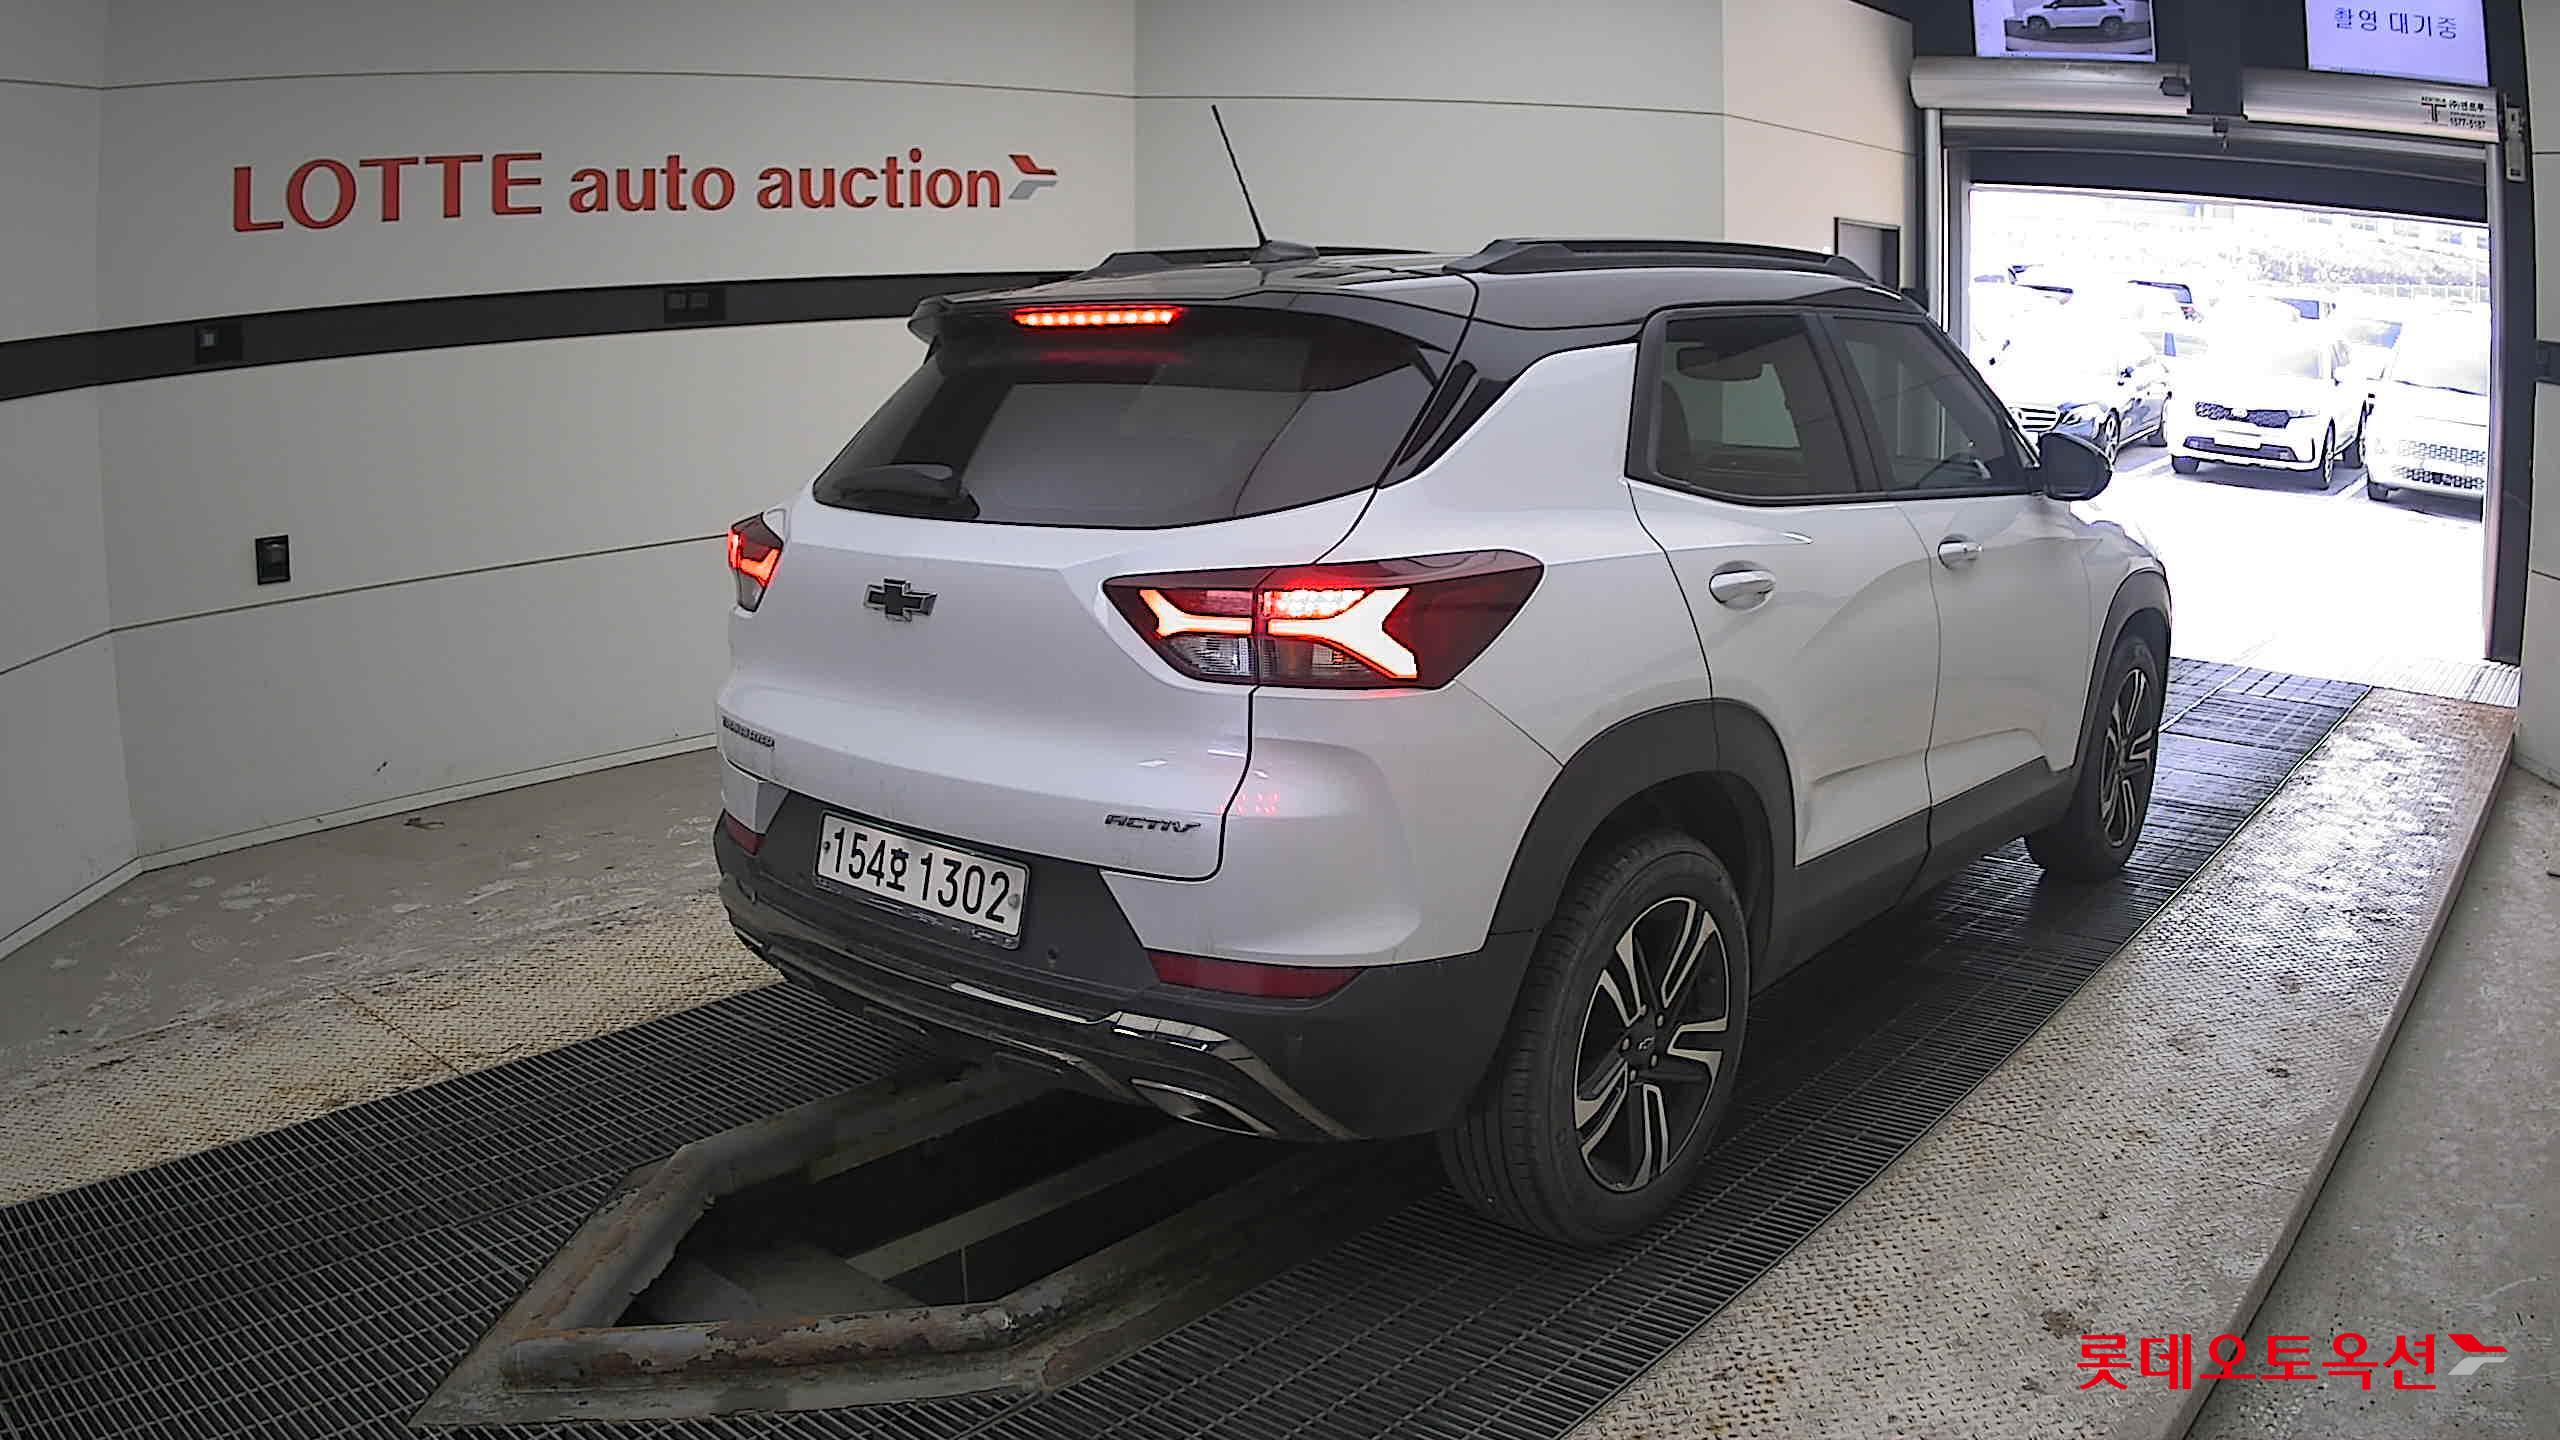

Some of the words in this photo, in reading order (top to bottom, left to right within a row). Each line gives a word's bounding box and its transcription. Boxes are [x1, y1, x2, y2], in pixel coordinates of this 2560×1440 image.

[233, 151, 544, 233] LOTTE
[568, 153, 736, 213] auto
[756, 147, 1002, 211] auction
[1104, 814, 1202, 833] ACTIV
[832, 826, 910, 893] 154호
[919, 852, 1011, 925] 1302
